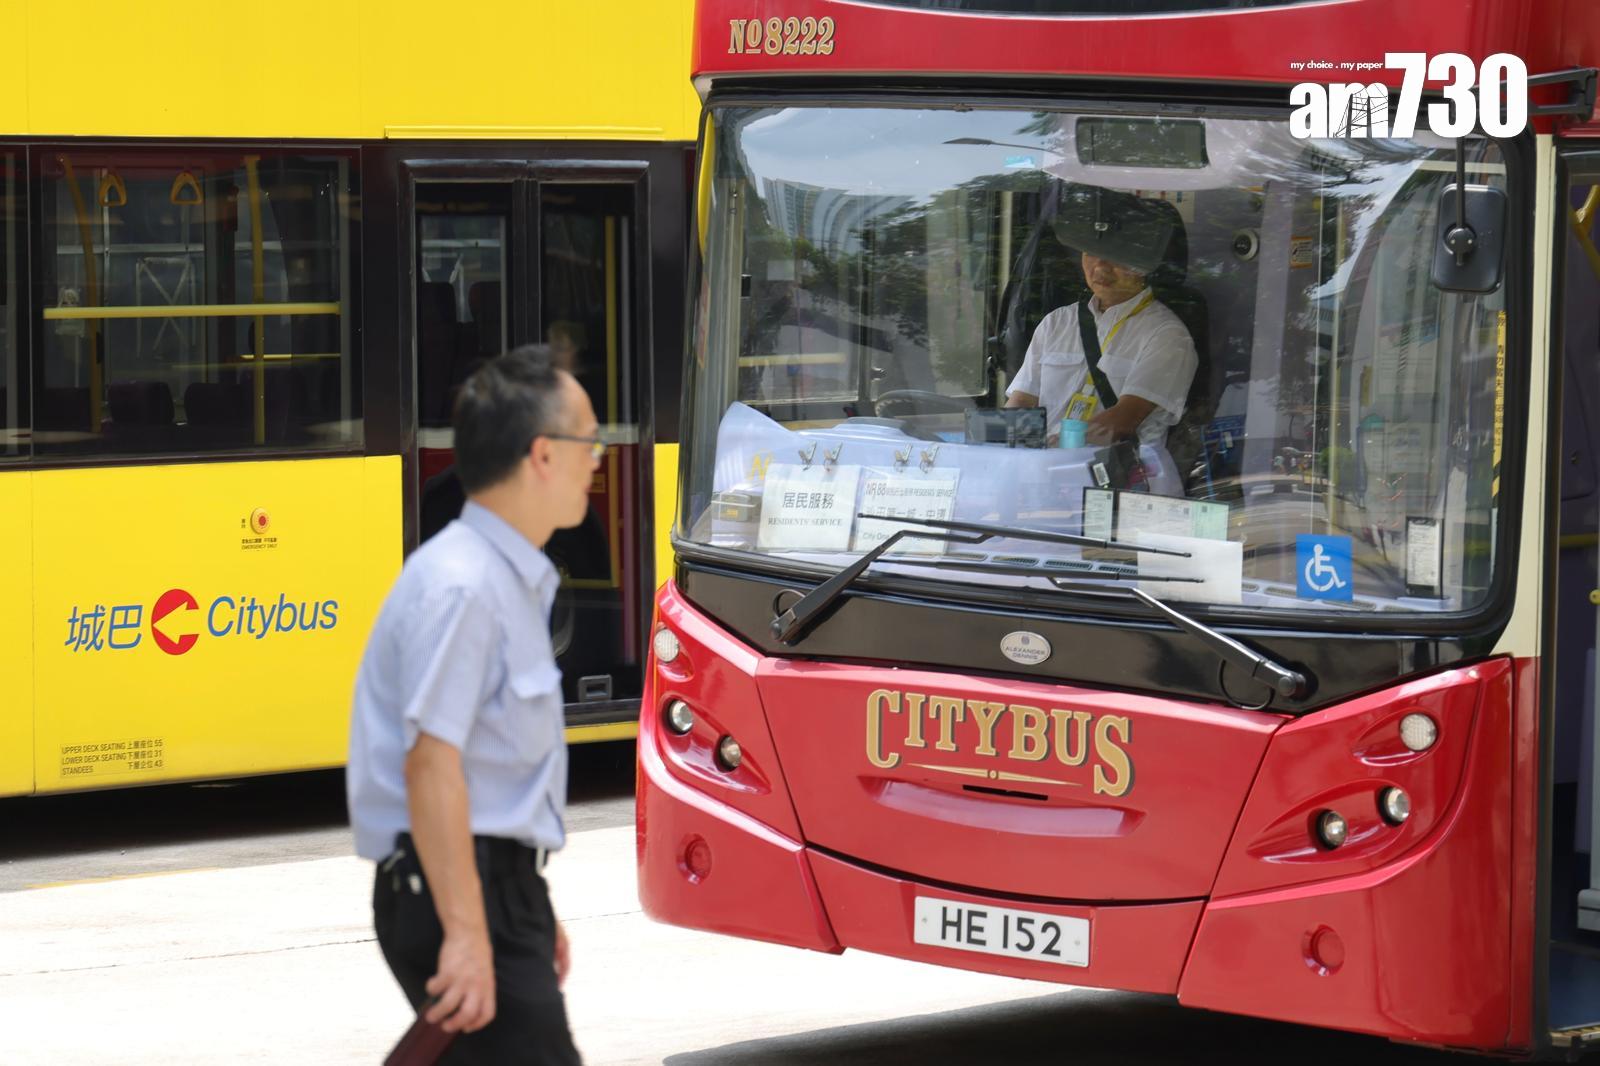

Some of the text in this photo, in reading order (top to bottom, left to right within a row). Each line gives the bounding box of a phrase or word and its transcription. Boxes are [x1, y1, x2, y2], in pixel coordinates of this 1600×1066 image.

[764, 16, 836, 55] 8222
[782, 492, 835, 509] 居民服務
[812, 518, 843, 526] SERVICE
[207, 593, 339, 639] Citybus
[65, 604, 143, 652] 城巴
[1006, 646, 1045, 655] ALEXANDER
[1012, 652, 1038, 660] DENNIS
[62, 742, 126, 755] UPPER DECK SEATING
[866, 688, 1135, 797] CITYBUS
[62, 752, 127, 765] LOWER DECK SEATING
[154, 750, 163, 758] 31
[62, 765, 94, 775] STANDEES
[941, 906, 1062, 957] HE 152
